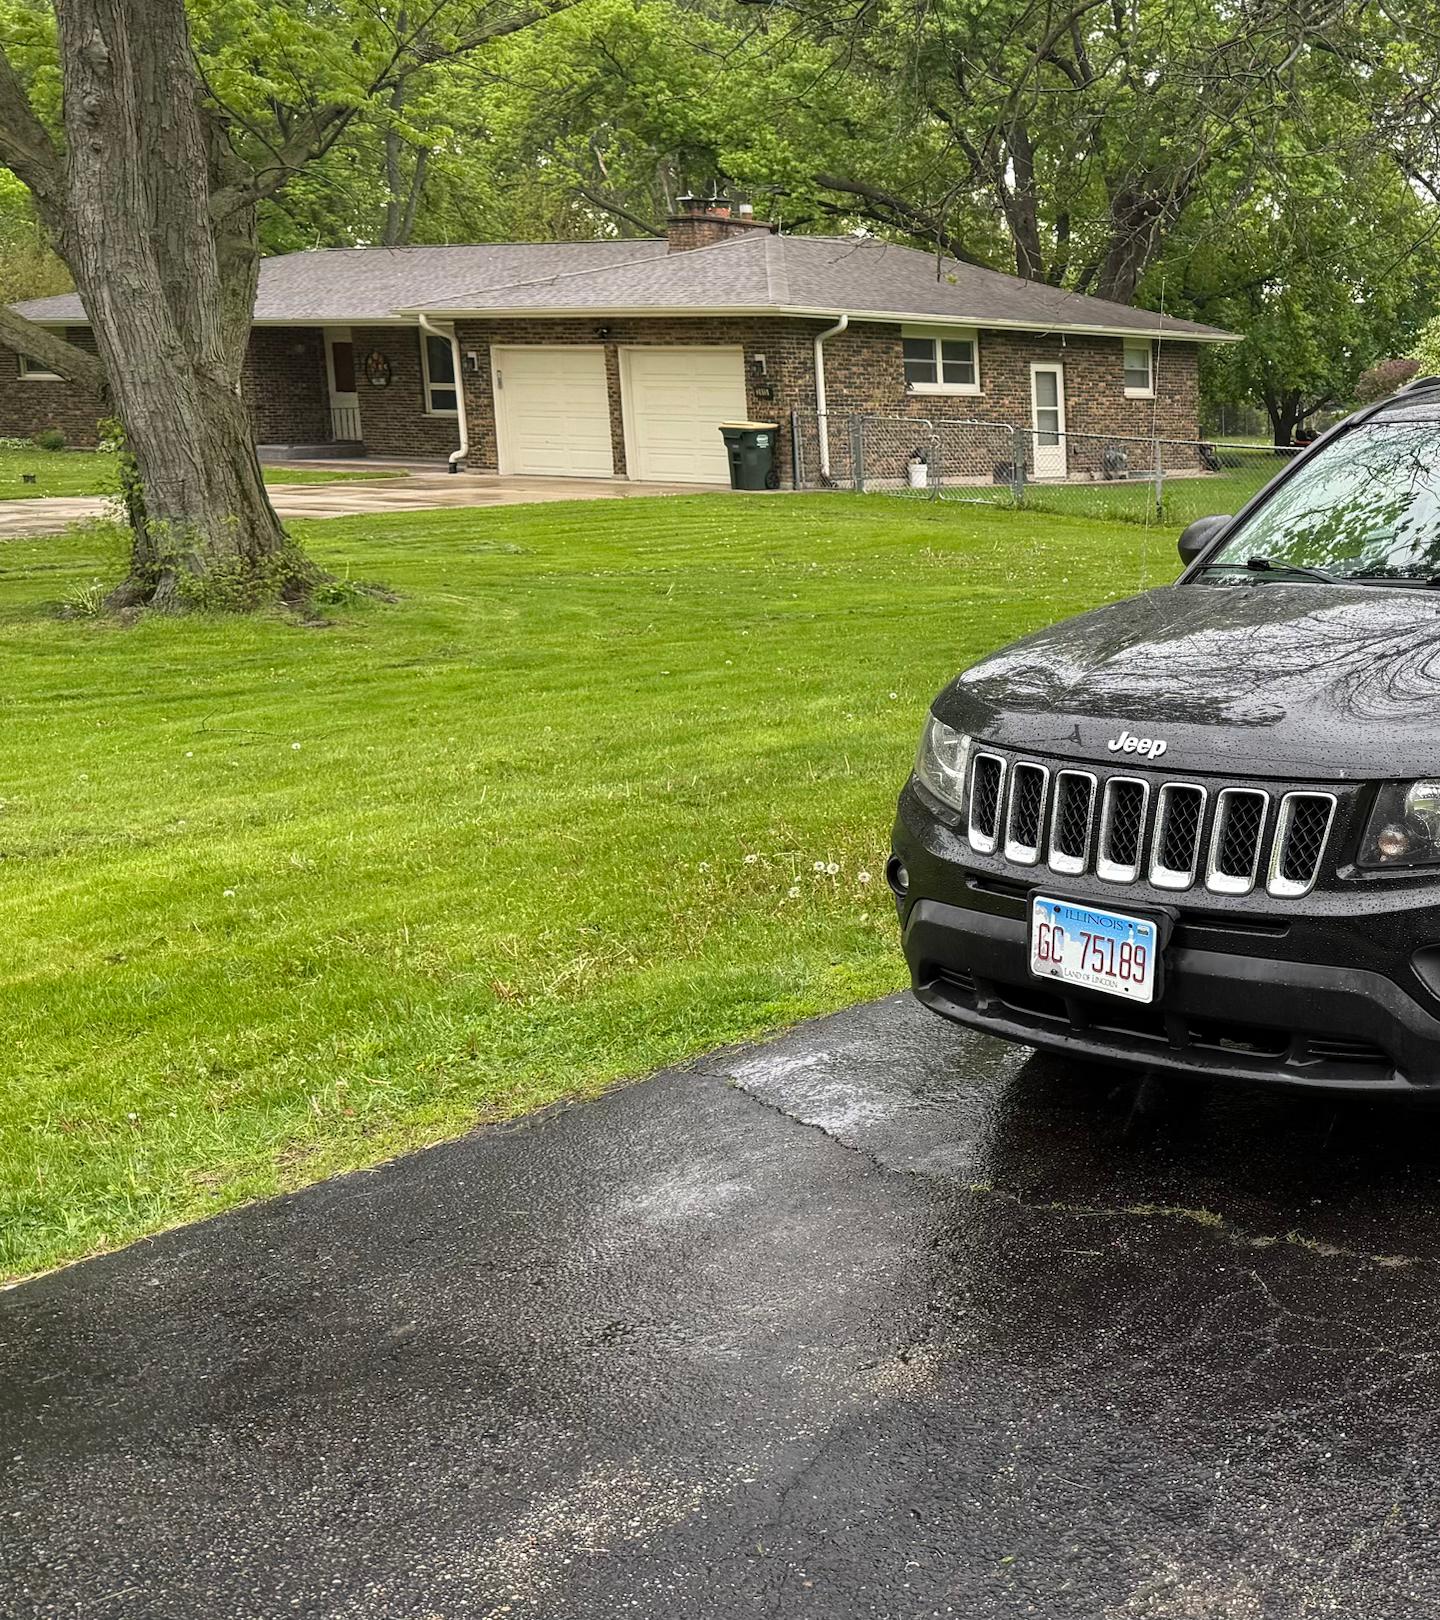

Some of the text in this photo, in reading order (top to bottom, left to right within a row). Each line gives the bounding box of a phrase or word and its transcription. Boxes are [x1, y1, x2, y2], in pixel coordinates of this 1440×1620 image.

[1107, 731, 1168, 760] Jeep
[1065, 909, 1124, 931] ILLINOIS
[1038, 922, 1146, 984] GC 75189
[1064, 967, 1118, 988] LAND OF LINCOLN
